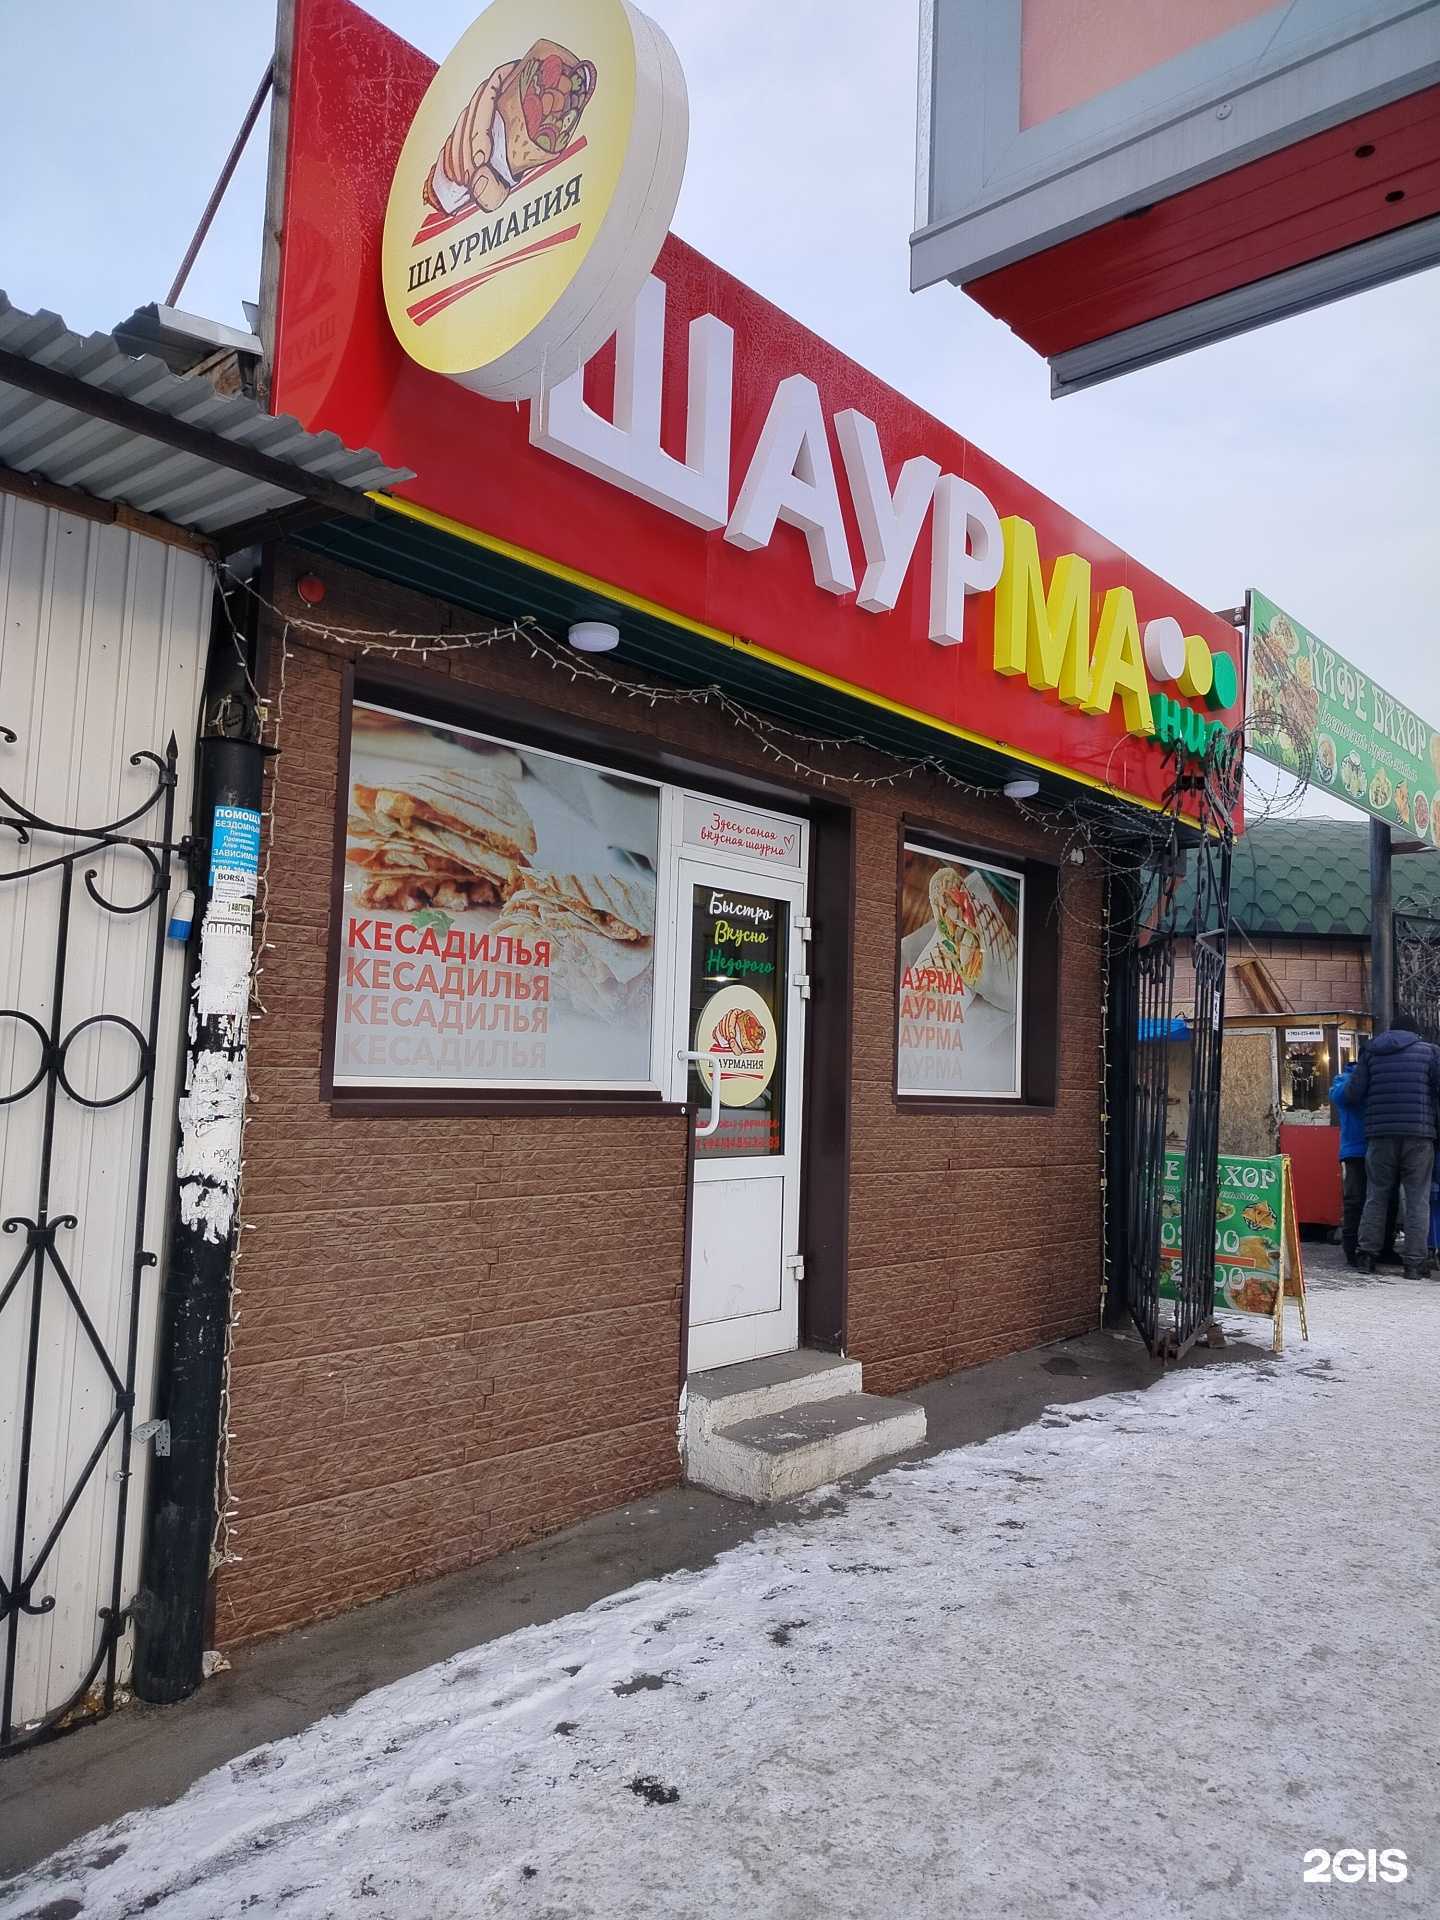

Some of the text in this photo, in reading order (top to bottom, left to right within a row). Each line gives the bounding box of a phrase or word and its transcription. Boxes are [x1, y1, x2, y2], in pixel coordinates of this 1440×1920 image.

[407, 174, 583, 292] ШАУРМАНИЯ
[700, 827, 785, 856] вкусная шаурма
[710, 813, 778, 840] Здесь самая
[217, 873, 246, 883] BORSA
[709, 891, 773, 925] Быстро
[348, 918, 550, 968] КЕСАДИЛЬЯ
[714, 920, 768, 946] Вкусно
[707, 948, 774, 976] Недорого
[346, 957, 549, 1002] КЕСАДИЛЬЯ
[344, 994, 548, 1035] КЕСАДИЛЬЯ
[342, 1032, 546, 1072] КЕСАДИЛЬЯ
